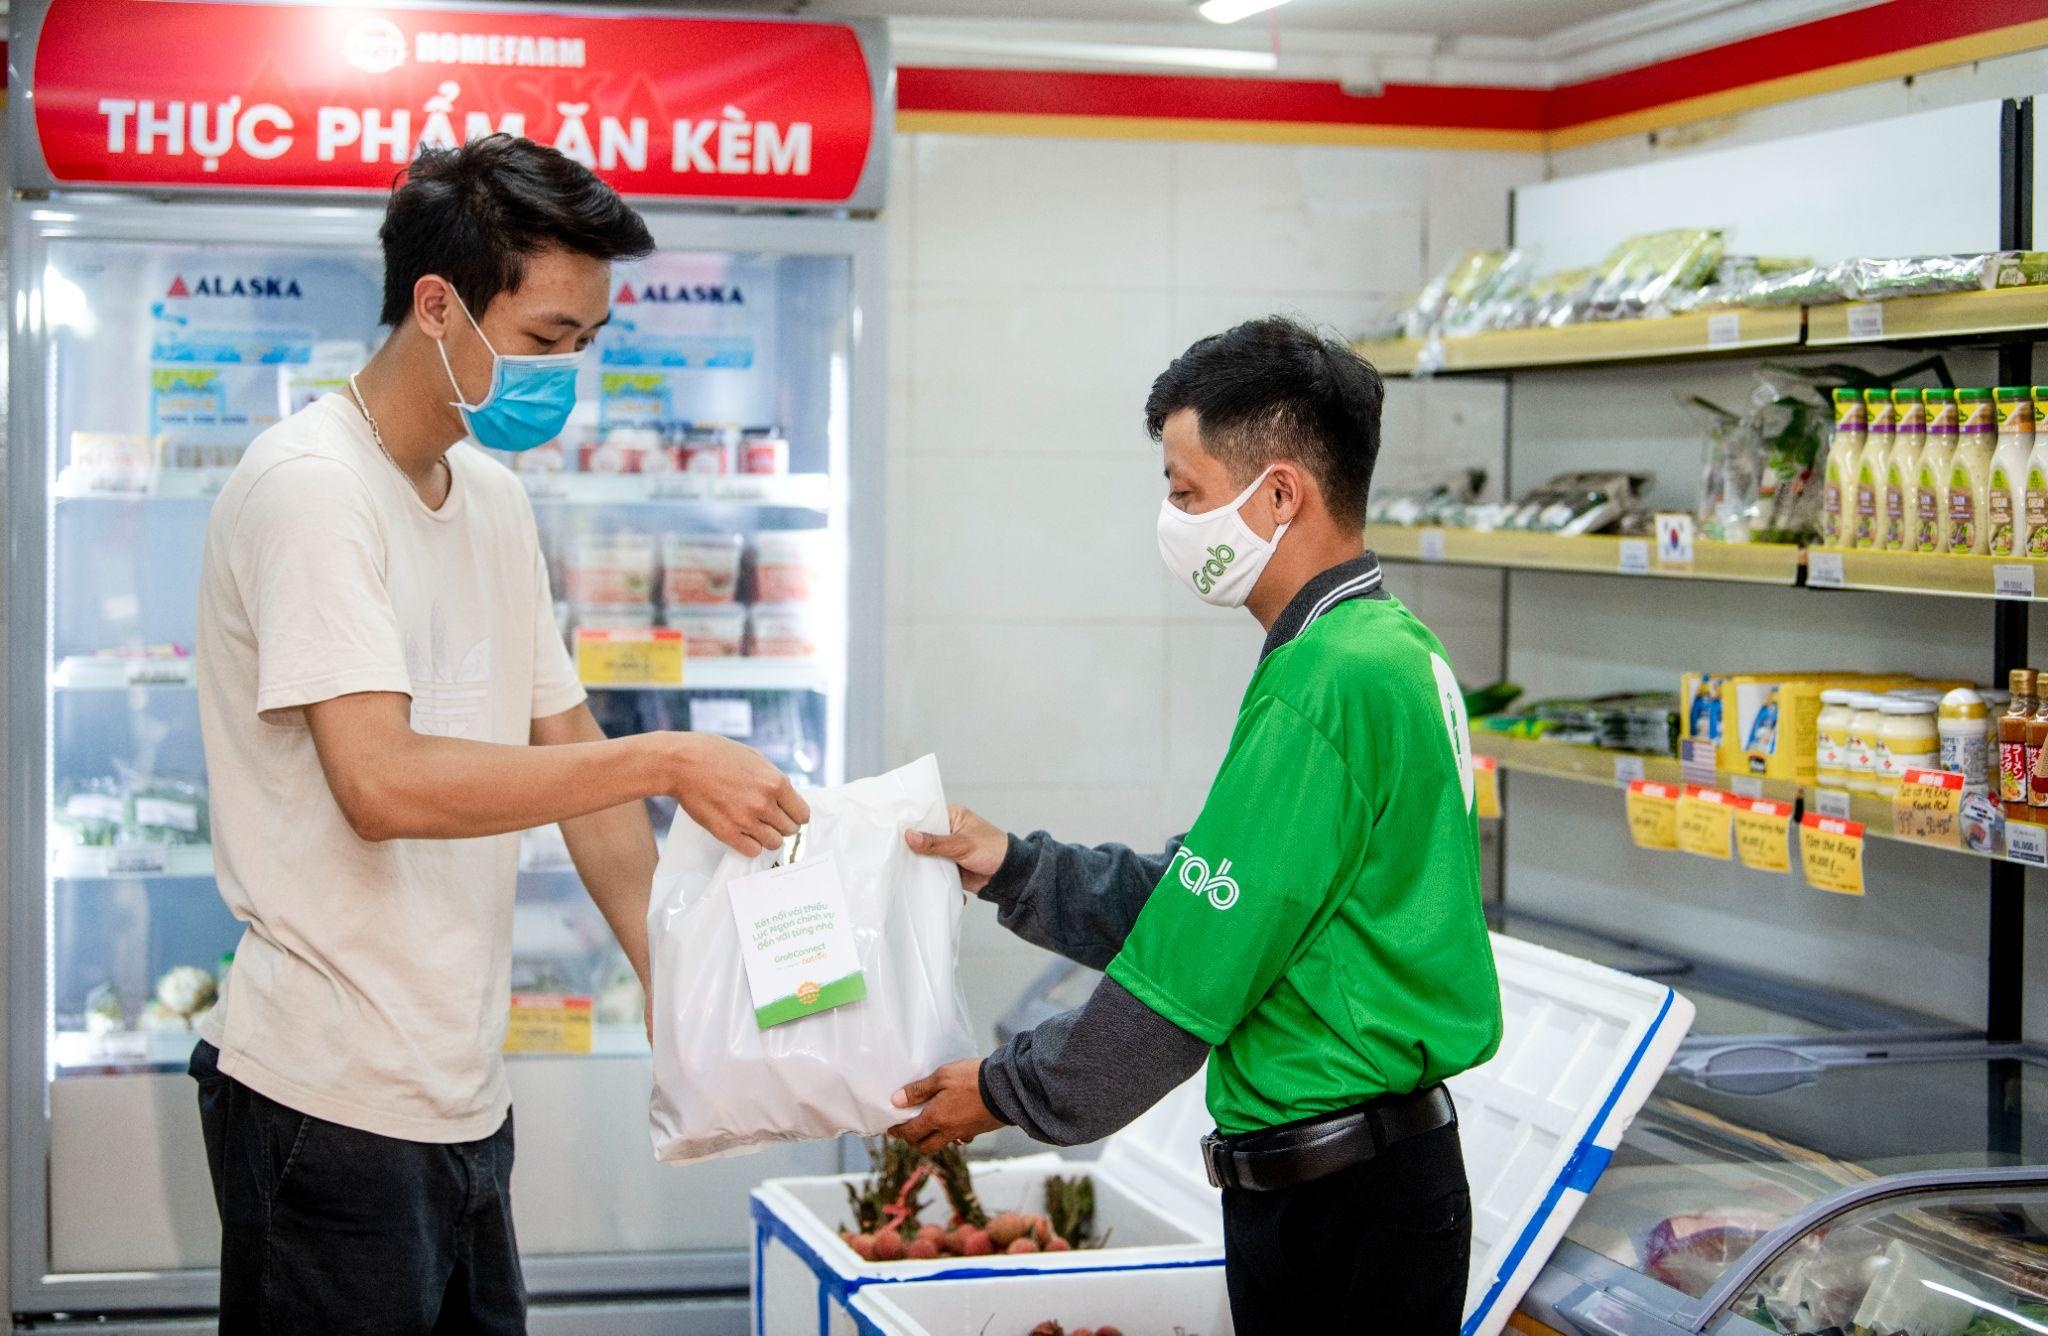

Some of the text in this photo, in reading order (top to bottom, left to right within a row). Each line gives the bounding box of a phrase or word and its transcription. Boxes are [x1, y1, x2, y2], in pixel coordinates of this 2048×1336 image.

[416, 32, 586, 68] HOMEFARM
[98, 94, 294, 172] THỰC
[555, 101, 649, 172] ĂN
[672, 103, 812, 176] KÈM
[196, 276, 302, 298] ALASKA
[643, 283, 744, 303] ALASKA
[1192, 544, 1235, 595] Grab
[1165, 845, 1240, 911] rab
